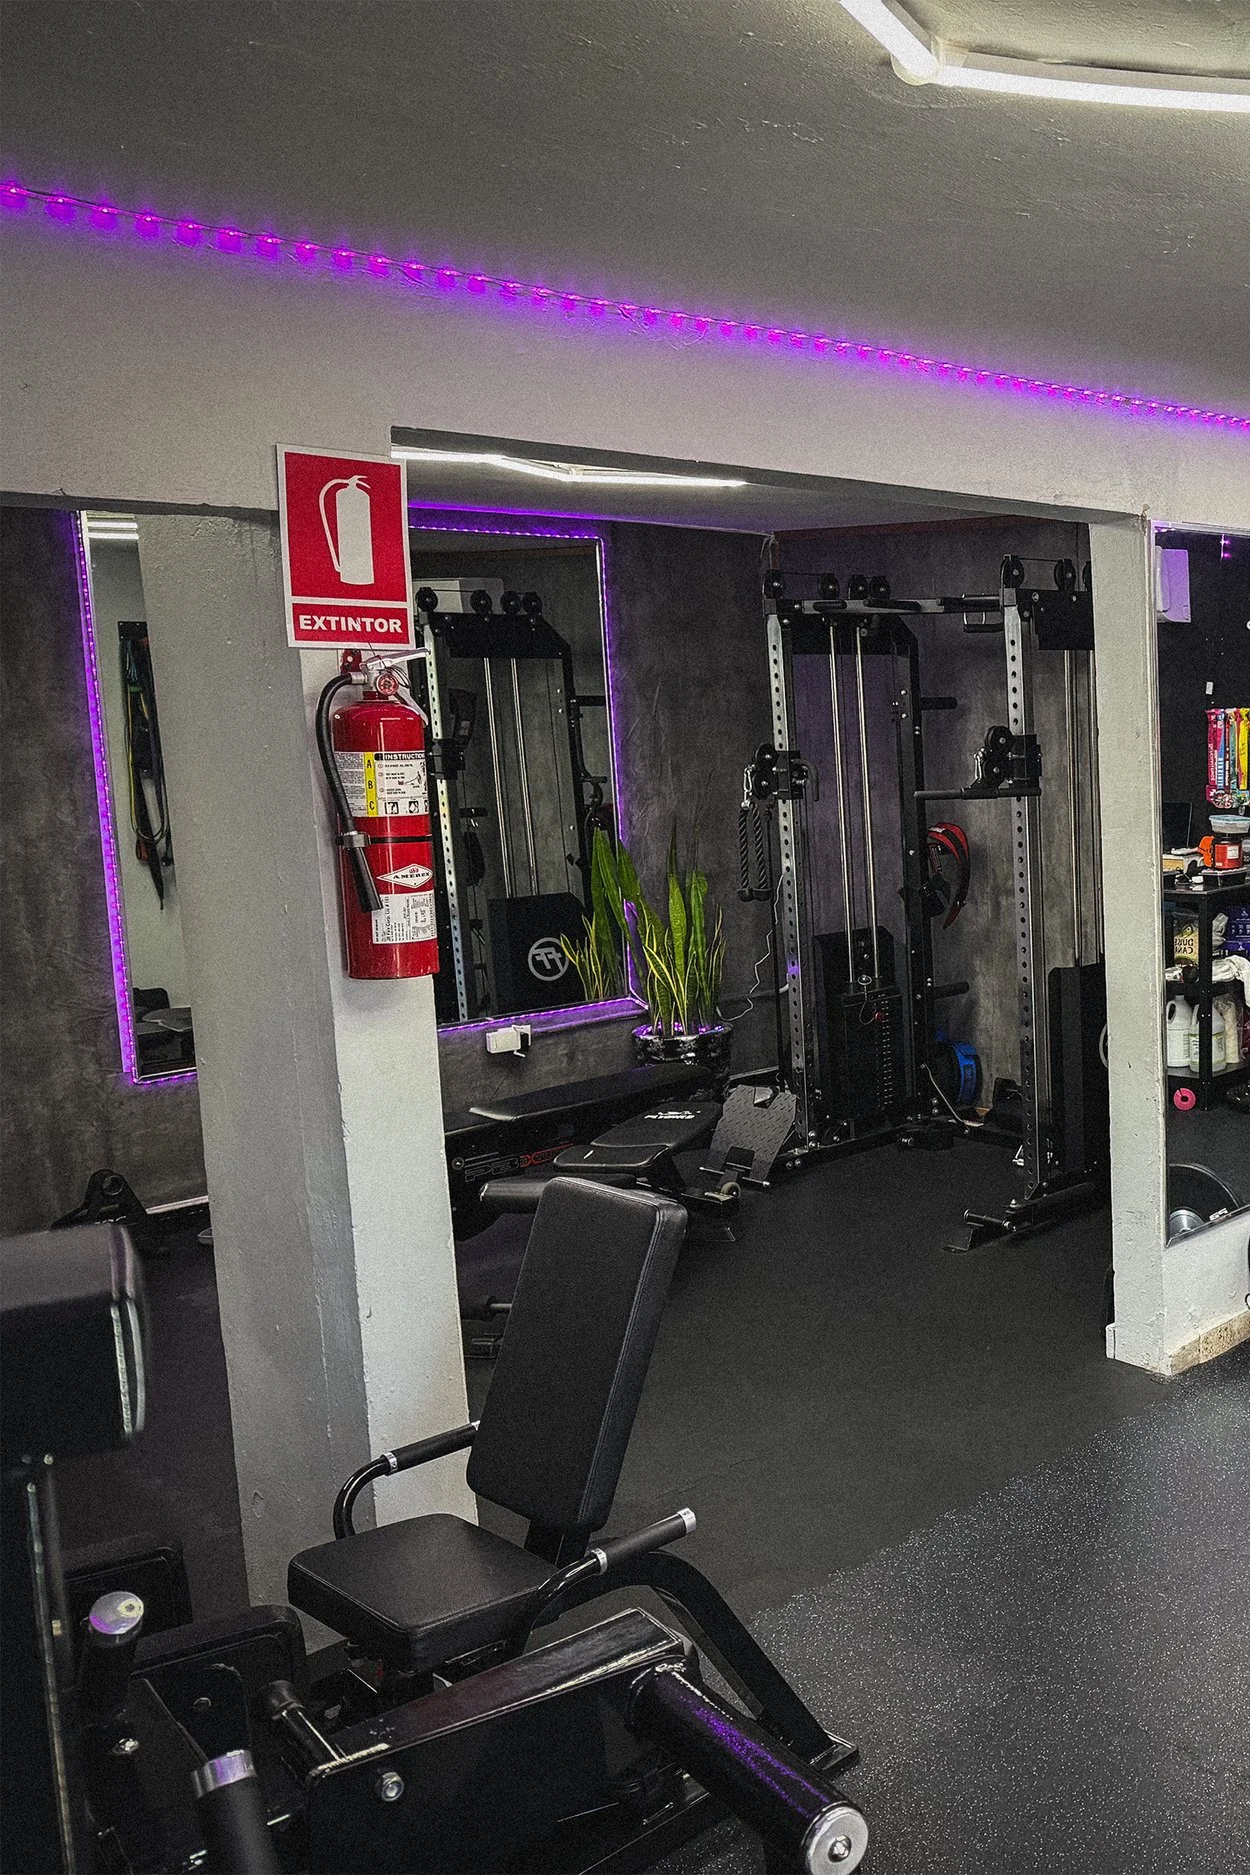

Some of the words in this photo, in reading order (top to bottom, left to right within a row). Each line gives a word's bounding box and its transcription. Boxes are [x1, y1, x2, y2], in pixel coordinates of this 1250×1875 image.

[298, 614, 403, 634] EXTINTOR
[366, 759, 372, 769] A
[368, 780, 373, 790] B
[369, 800, 375, 811] C
